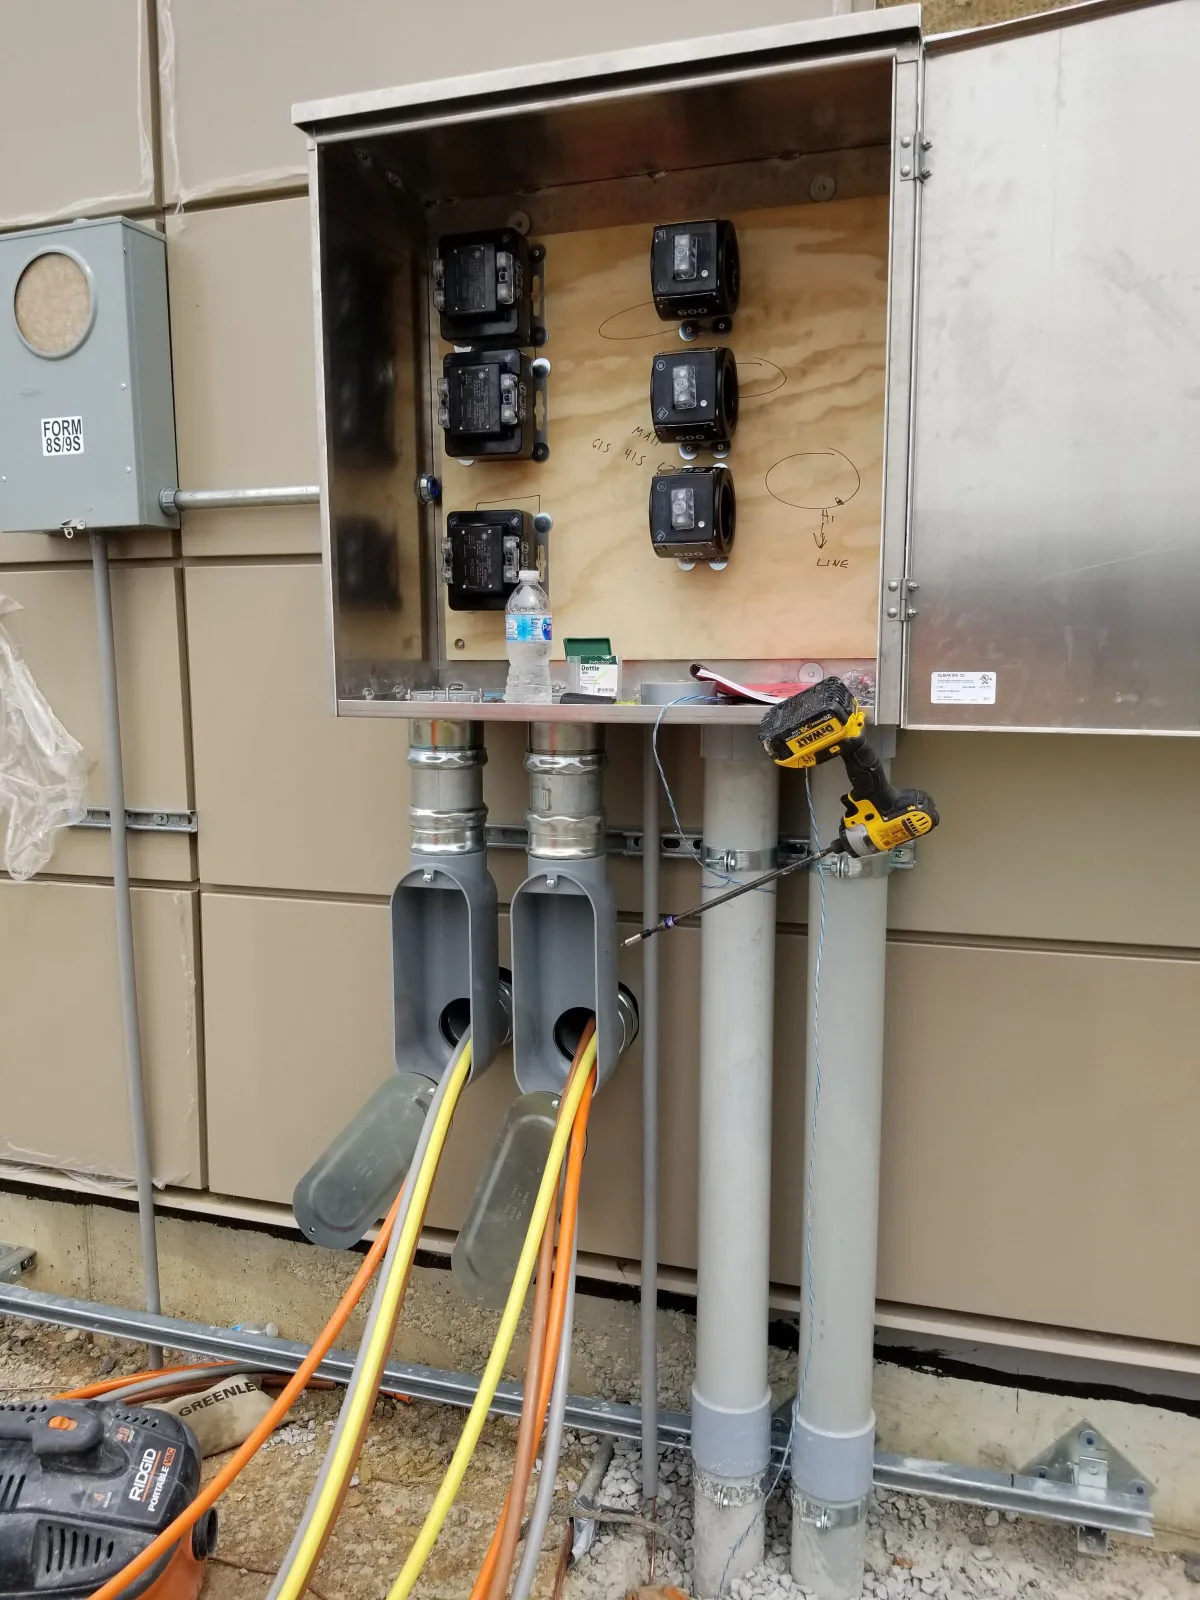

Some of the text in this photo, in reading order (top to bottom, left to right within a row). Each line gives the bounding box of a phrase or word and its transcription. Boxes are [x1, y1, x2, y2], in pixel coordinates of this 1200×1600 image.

[677, 307, 708, 316] 600
[43, 419, 82, 437] FORM
[46, 436, 81, 453] 8S/9S
[816, 558, 849, 569] LINE
[128, 1448, 157, 1501] RIDGID
[147, 1448, 176, 1512] PORTABLE VAC
